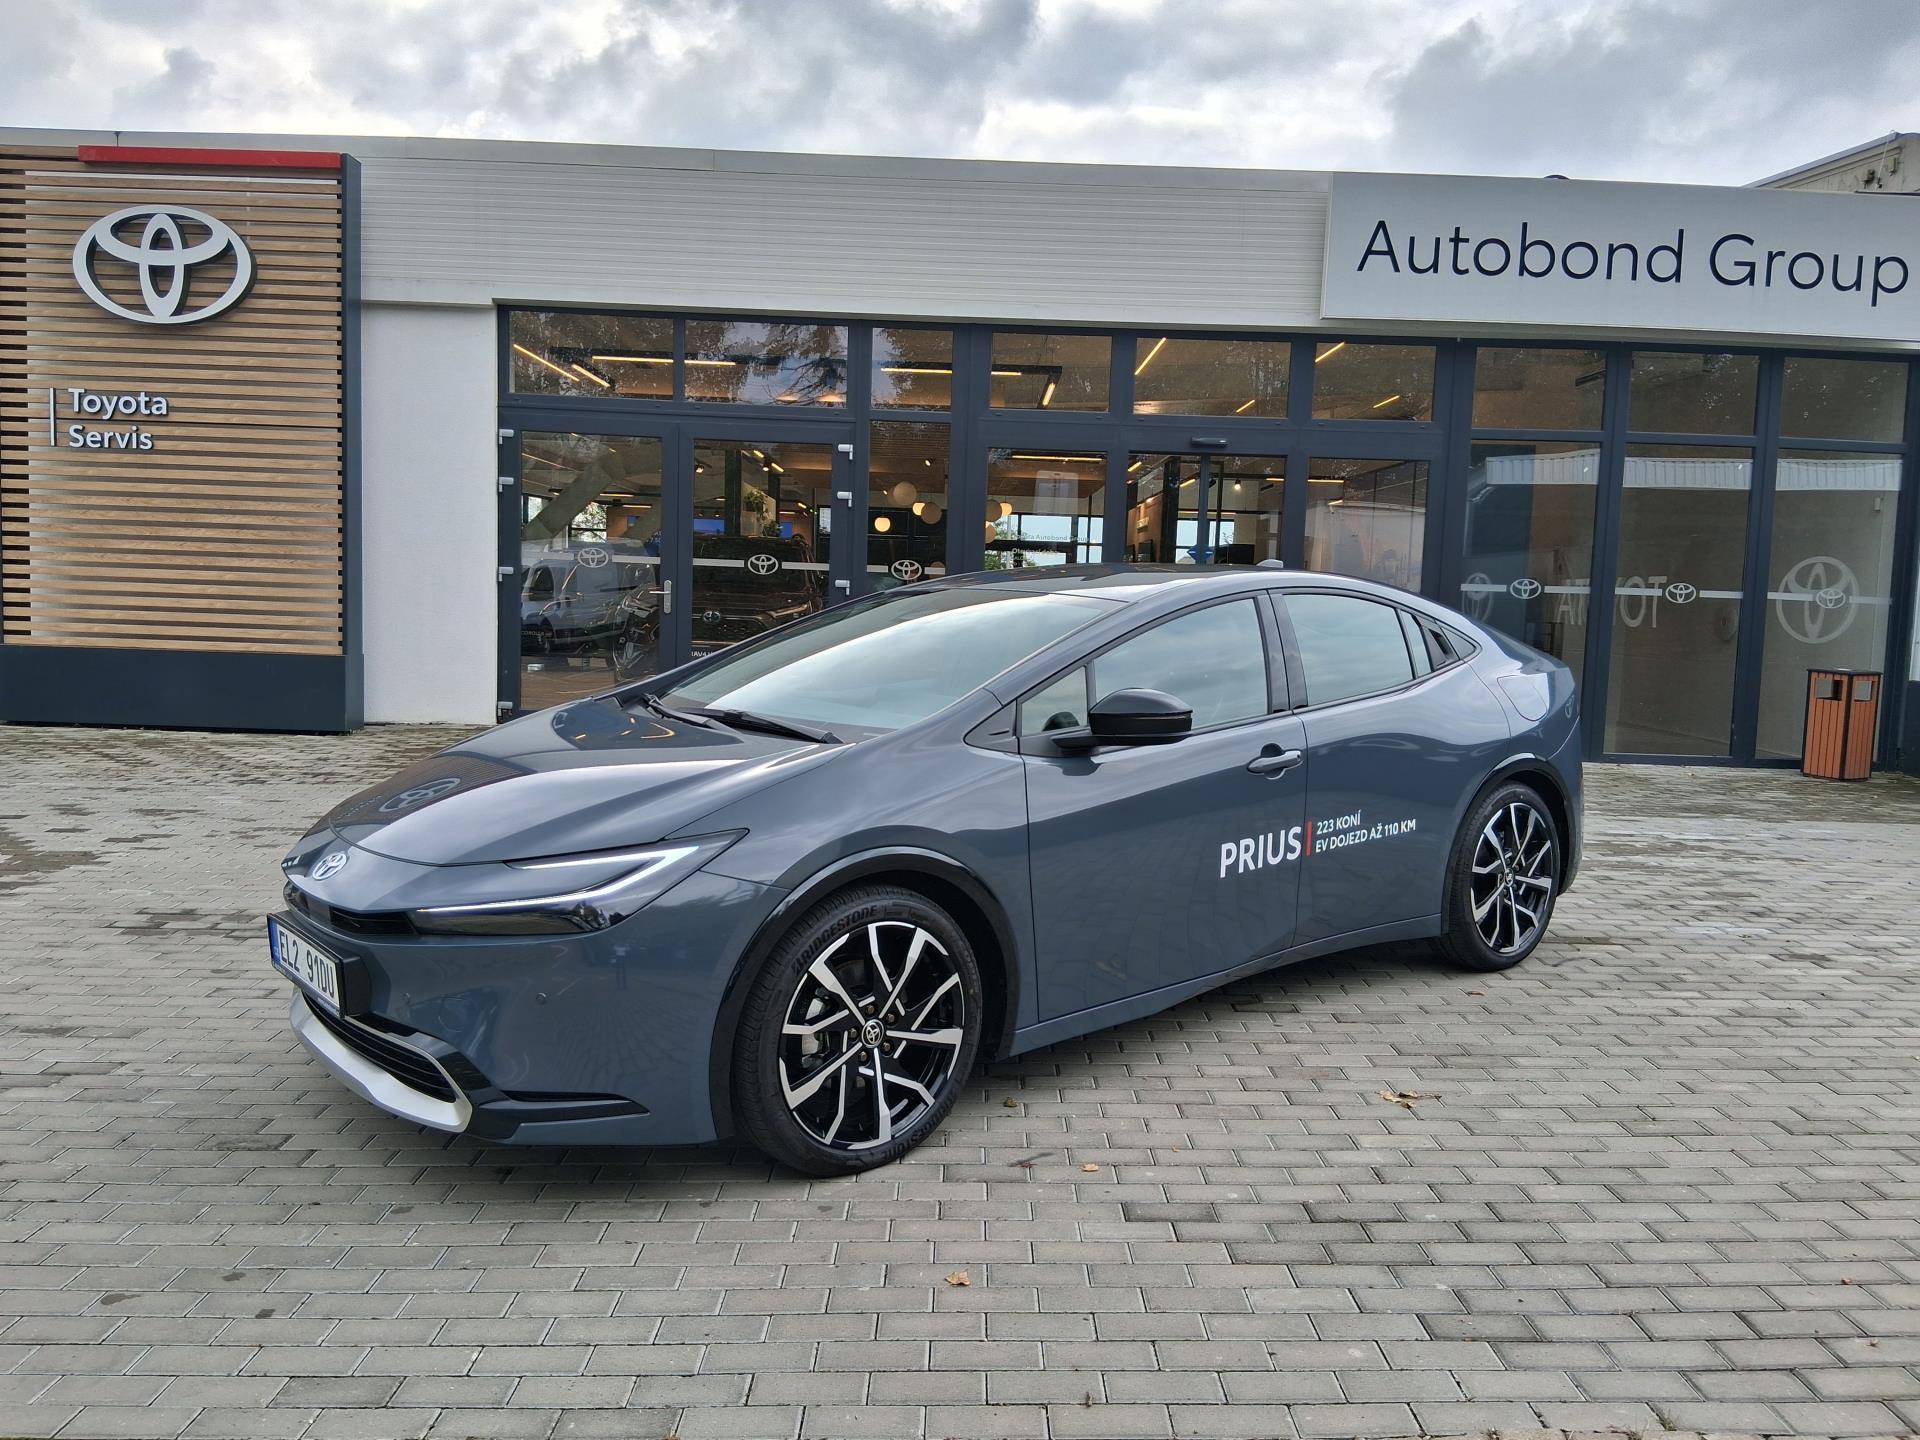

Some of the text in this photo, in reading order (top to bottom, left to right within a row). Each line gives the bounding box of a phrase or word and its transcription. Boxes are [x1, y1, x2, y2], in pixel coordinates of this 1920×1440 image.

[1356, 219, 1909, 308] Autobond Group
[67, 387, 168, 420] Toyota
[68, 424, 153, 450] Servis
[1315, 818, 1417, 854] EV DOJEZD AŽ 110 KM
[1316, 810, 1361, 835] 223 KONÍ
[1219, 826, 1302, 879] PRIUS
[279, 930, 300, 973] EL2
